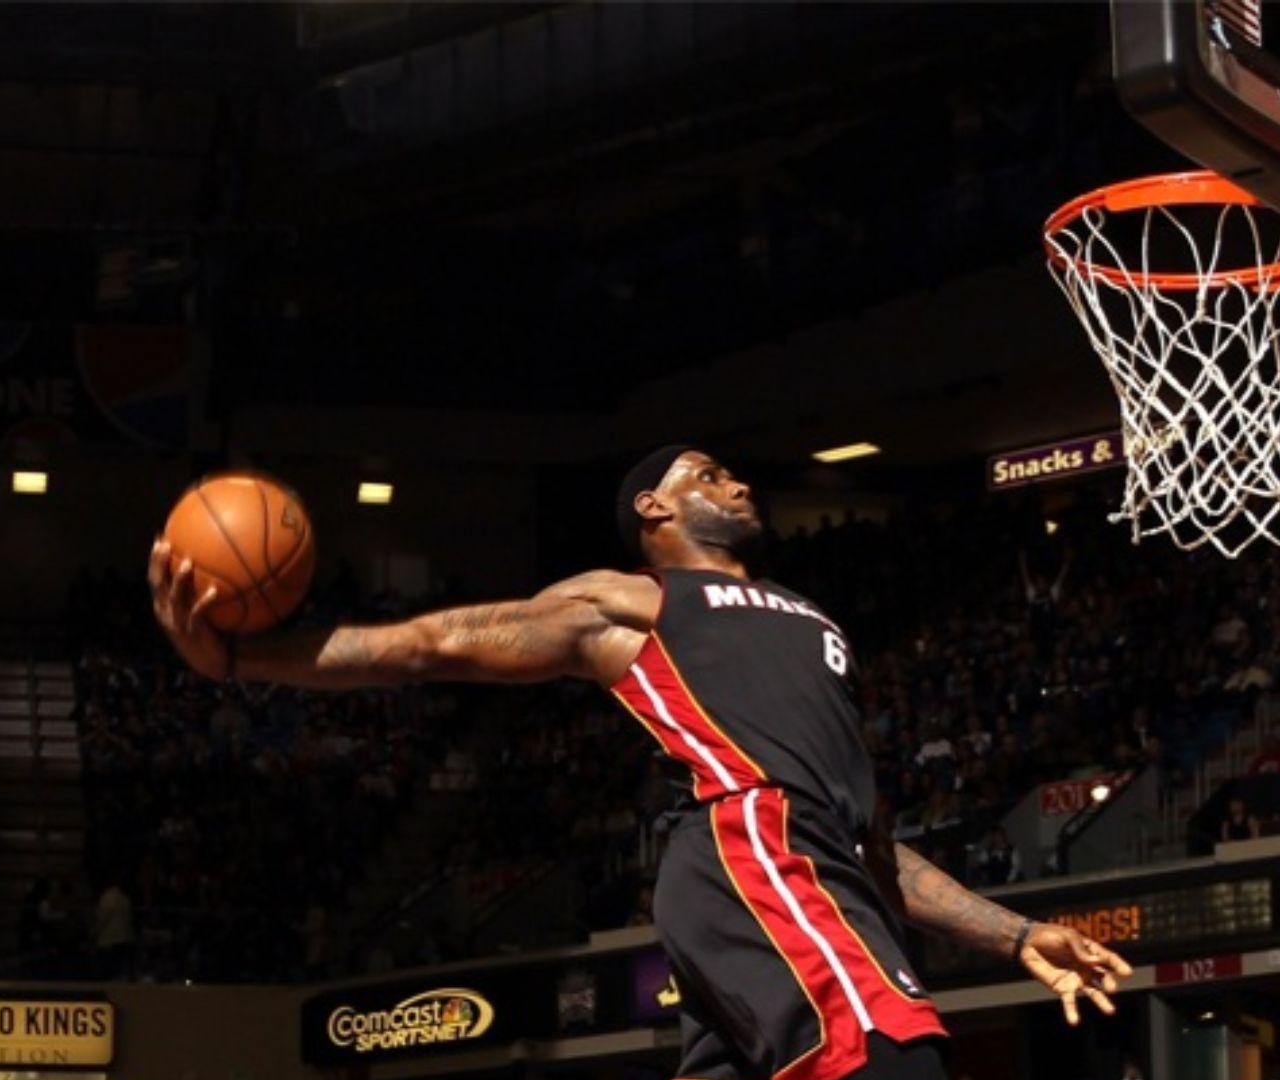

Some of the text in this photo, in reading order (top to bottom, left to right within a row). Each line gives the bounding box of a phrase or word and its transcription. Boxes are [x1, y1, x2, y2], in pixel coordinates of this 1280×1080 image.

[993, 450, 1084, 482] Snacks
[1091, 439, 1114, 464] &
[703, 584, 843, 636] MIA
[823, 630, 848, 676] 6
[1182, 958, 1215, 981] 102
[24, 1006, 106, 1038] KINGS
[355, 1019, 472, 1051] SPORTSNET
